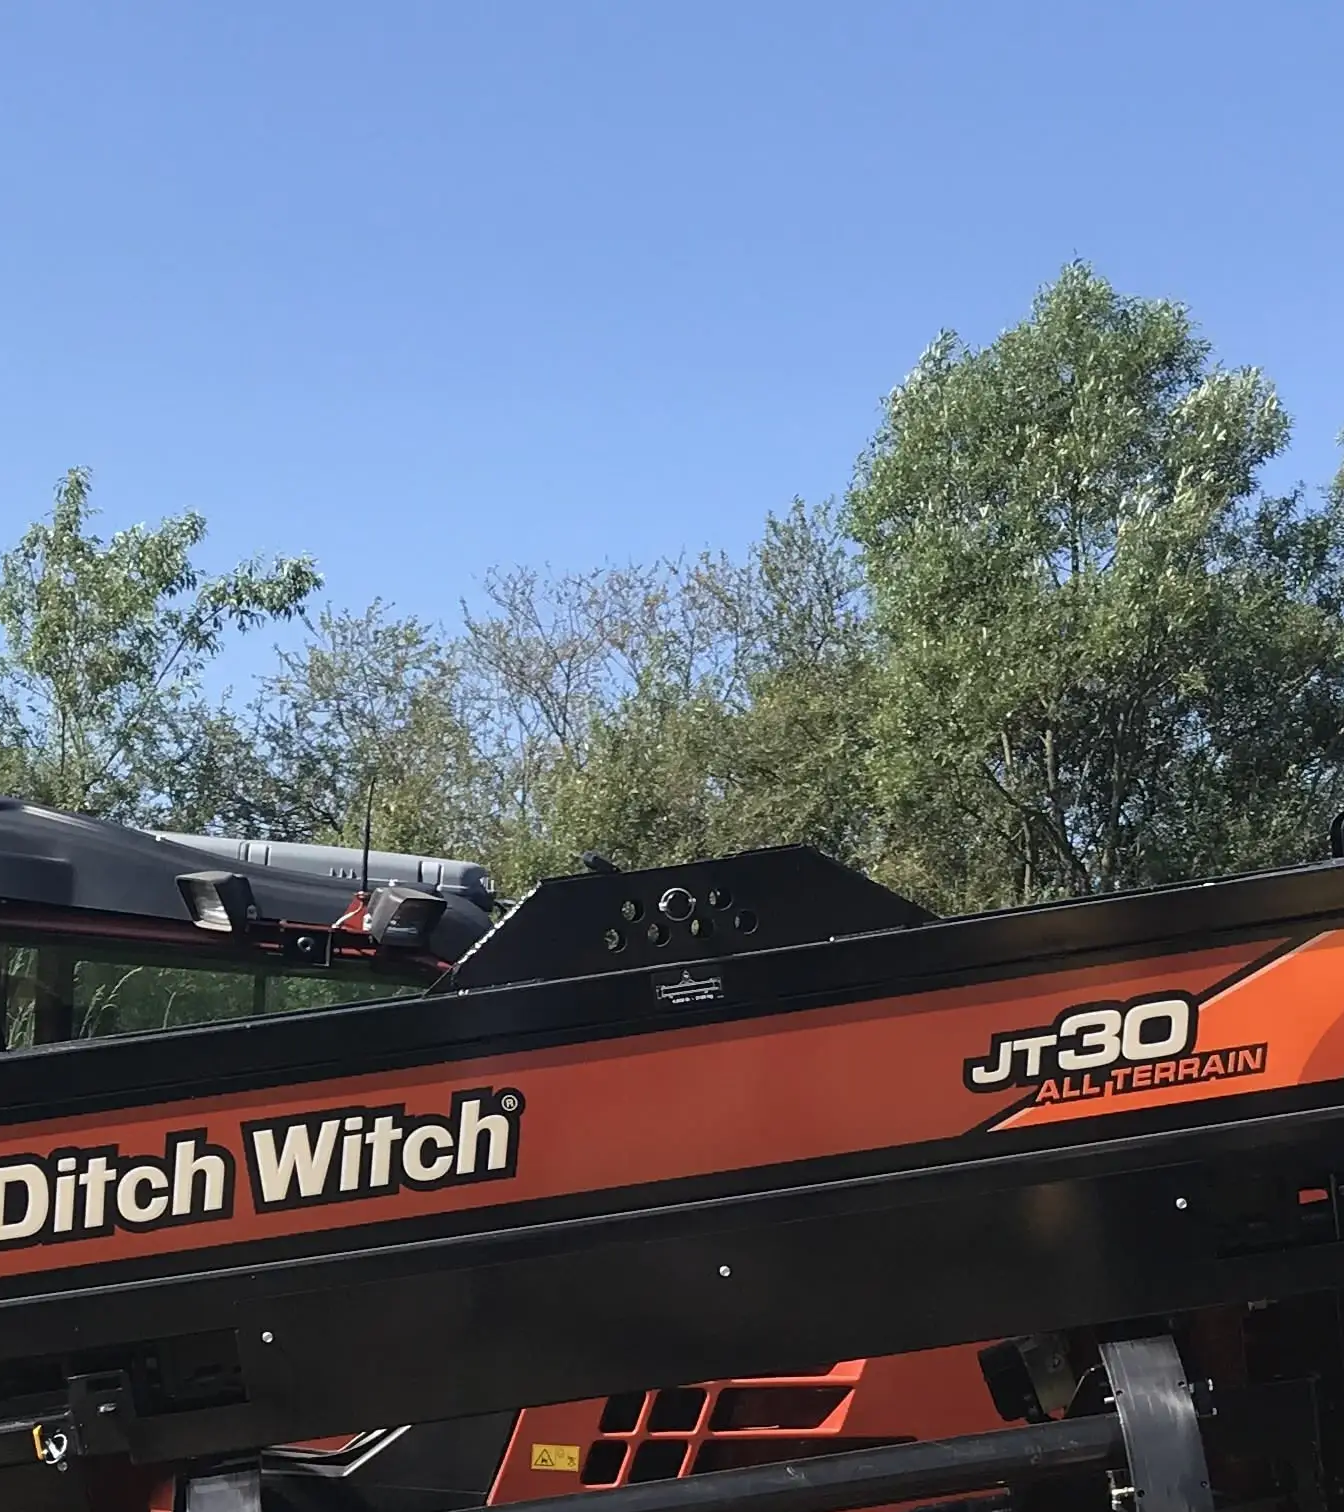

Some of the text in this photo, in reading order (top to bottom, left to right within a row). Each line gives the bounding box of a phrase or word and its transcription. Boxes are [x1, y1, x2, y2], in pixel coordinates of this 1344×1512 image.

[971, 999, 1190, 1085] JT30
[1035, 1047, 1263, 1103] ALL TERRAIN
